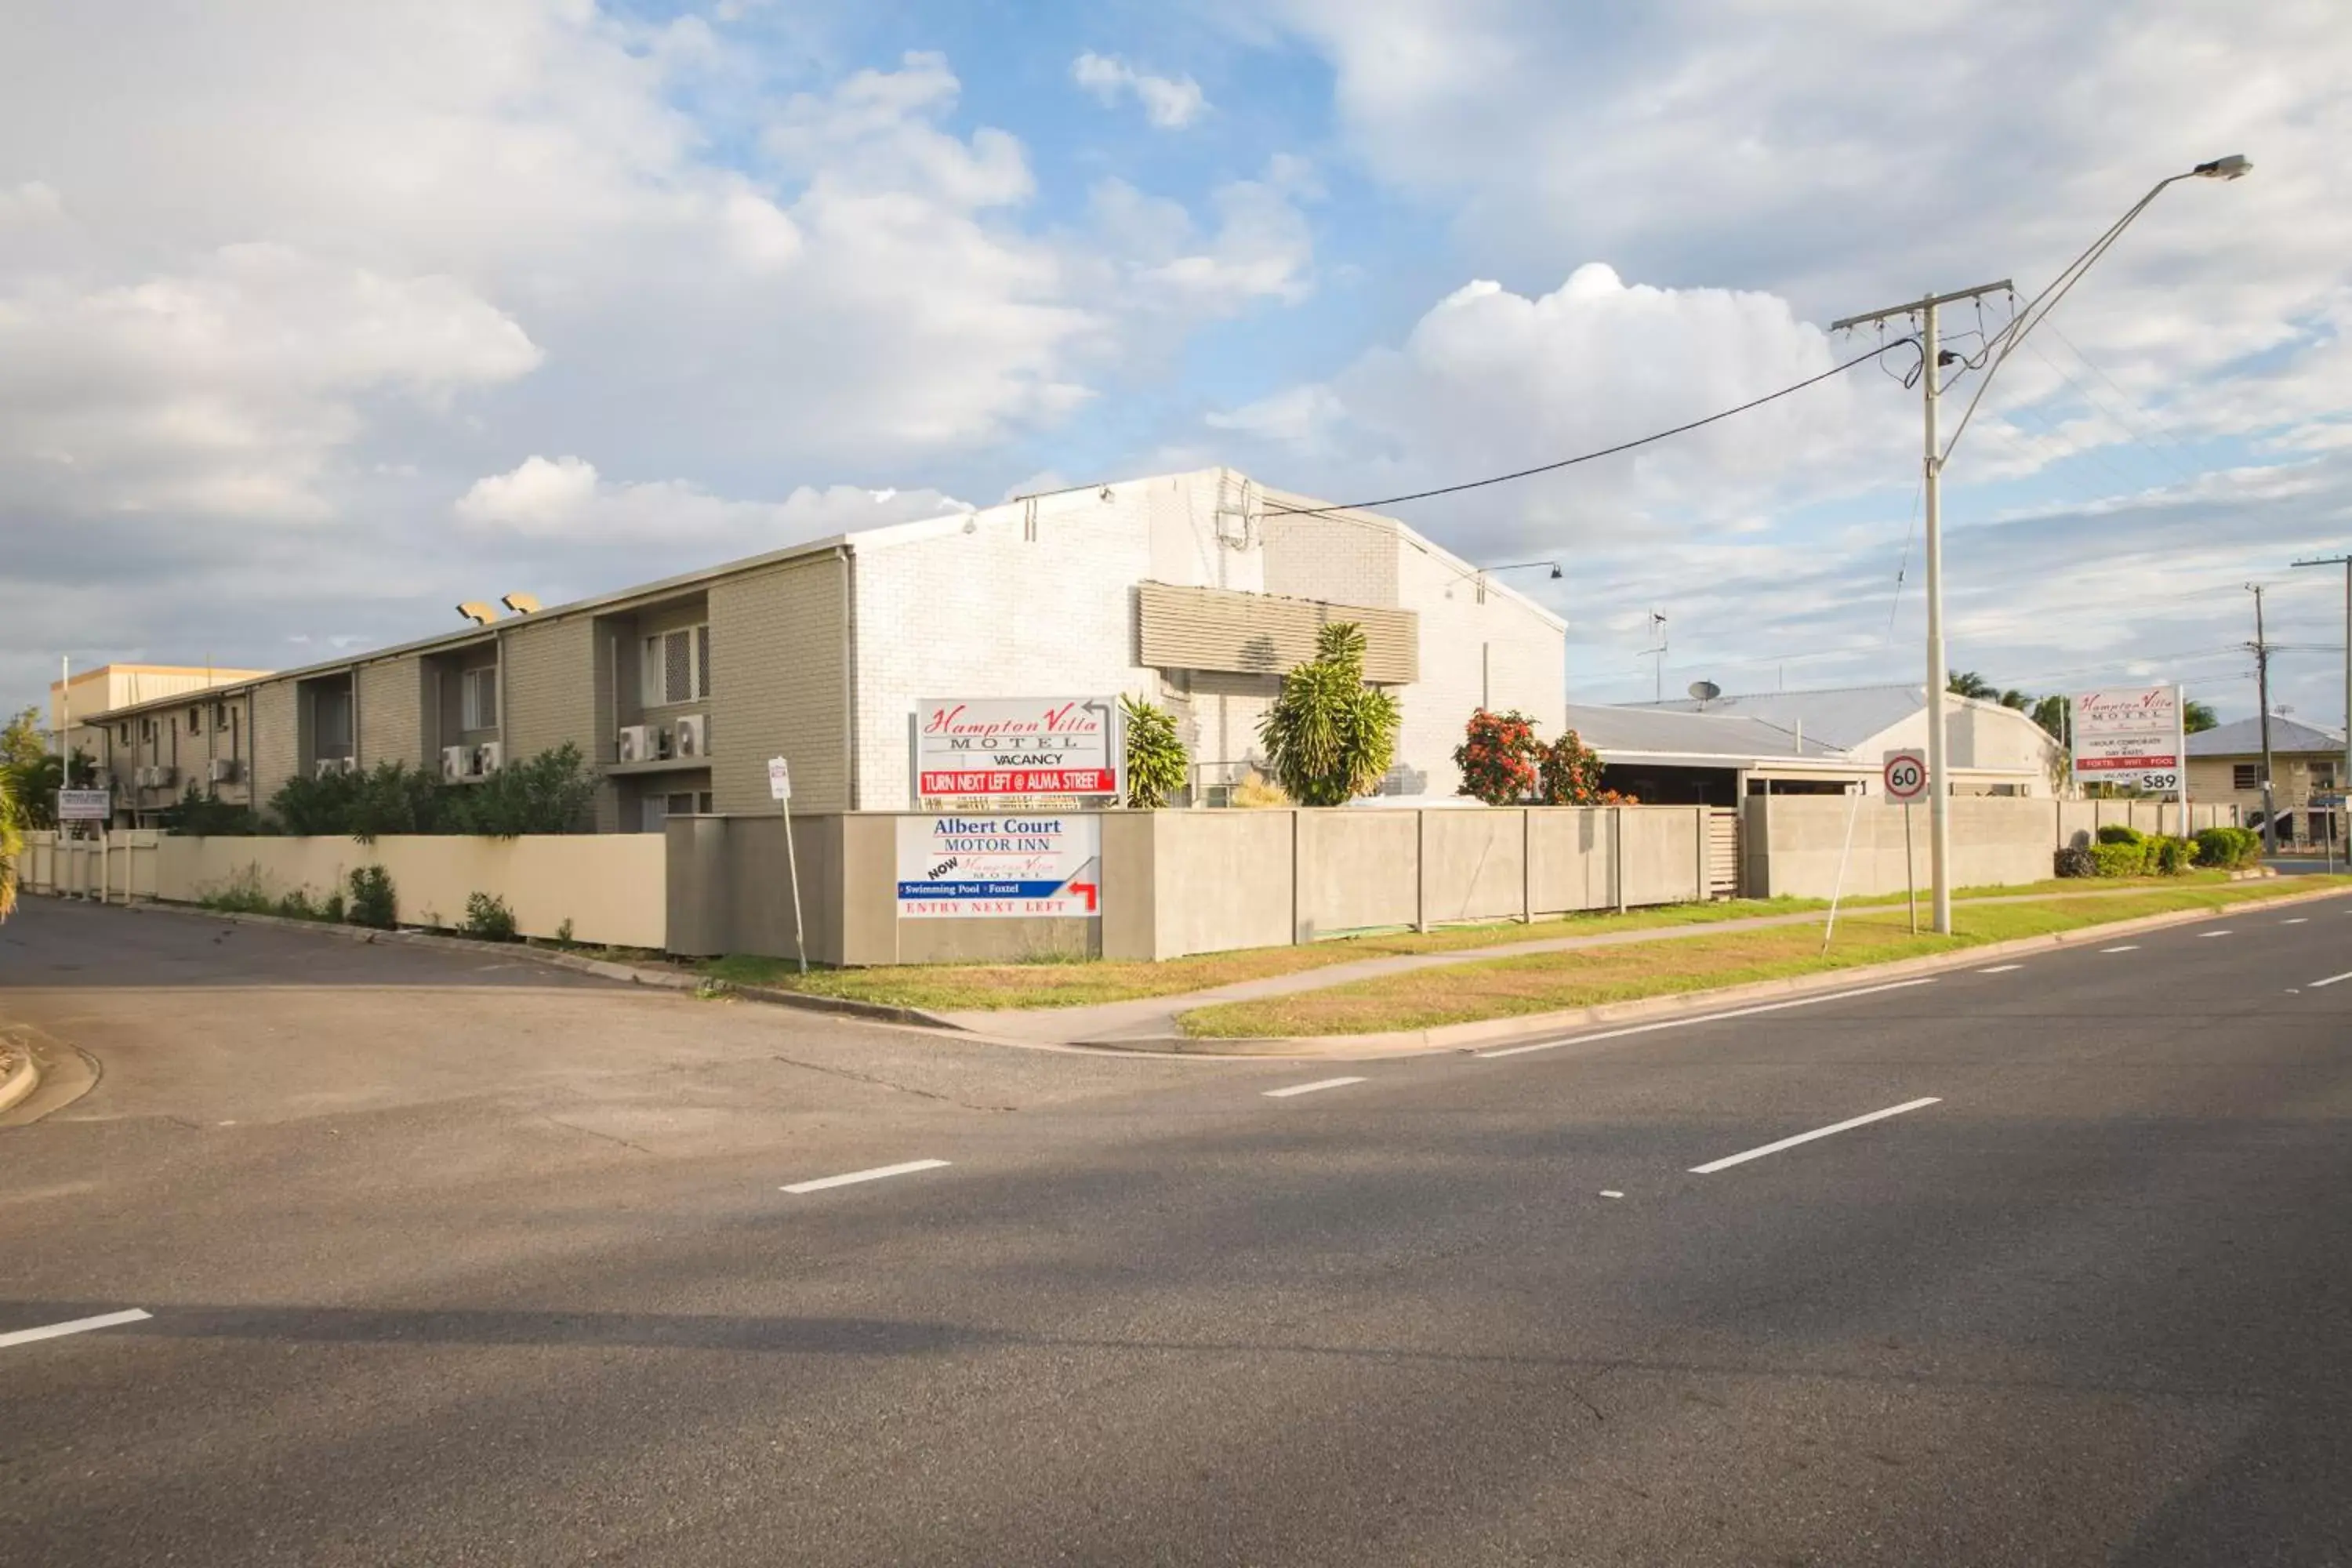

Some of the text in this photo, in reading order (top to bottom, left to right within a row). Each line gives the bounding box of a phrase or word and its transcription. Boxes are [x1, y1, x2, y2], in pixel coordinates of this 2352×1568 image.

[2082, 690, 2172, 711] Hampton Villa
[924, 702, 1098, 736] Hampton Villa
[2092, 712, 2161, 720] MOTEL
[951, 738, 1077, 750] MOTEL
[994, 753, 1063, 765] VACANCY
[924, 771, 1099, 791] TURN NEXT LEFT @ ALMA STREET
[1892, 768, 1916, 786] 60
[934, 818, 1061, 834] Albert Court
[945, 837, 1051, 851] MOTOR INN
[927, 856, 959, 880] NOW
[906, 884, 1019, 895] Swimming Pool Foxtel
[906, 901, 1065, 913] ENTRY NEXT LEFT
